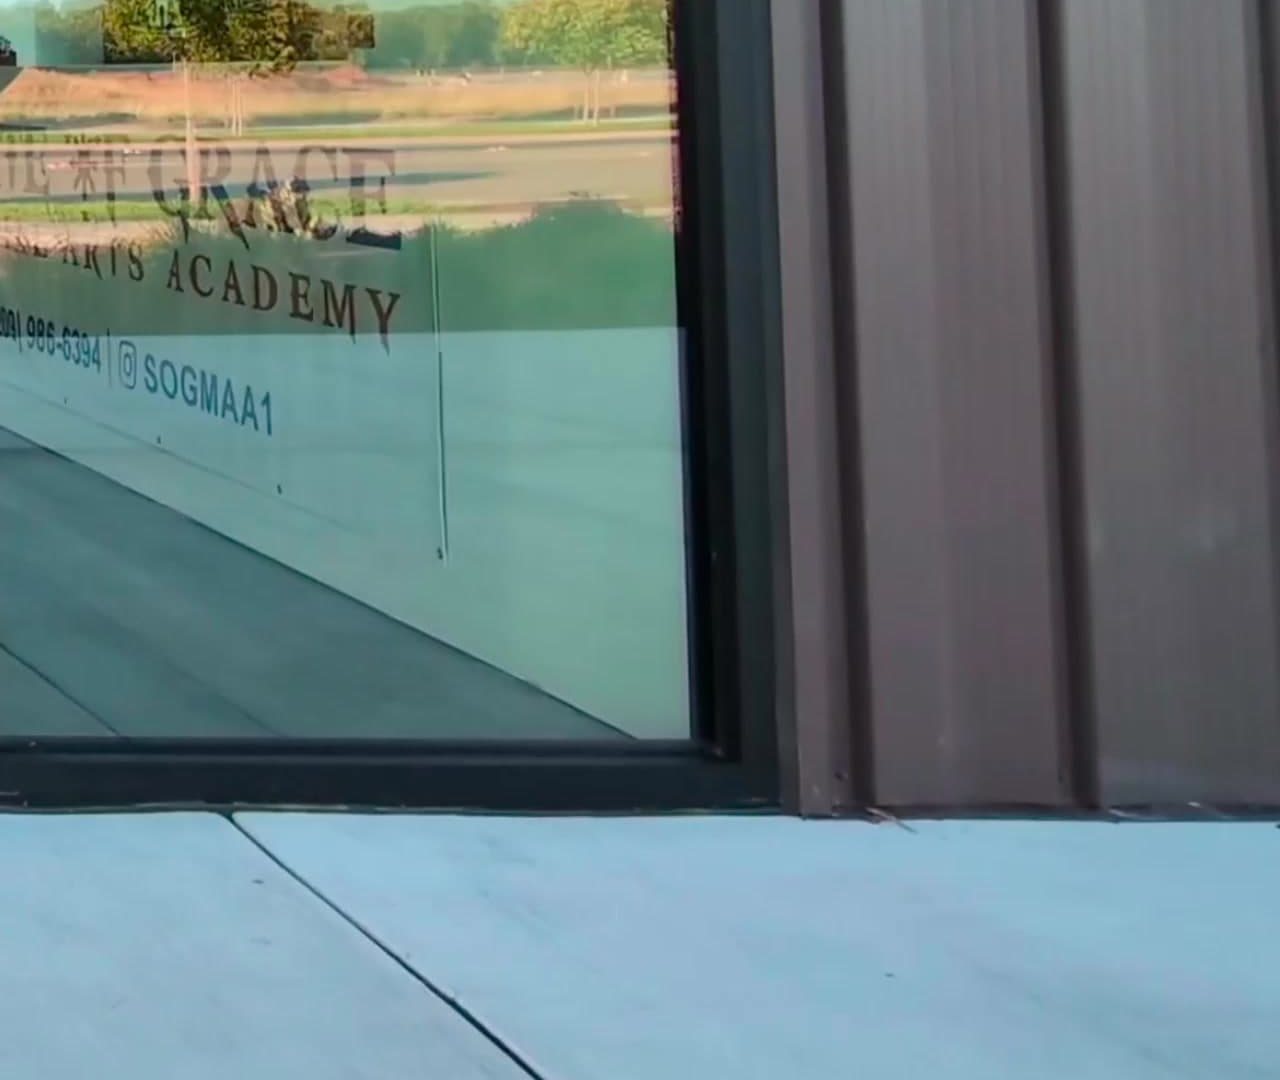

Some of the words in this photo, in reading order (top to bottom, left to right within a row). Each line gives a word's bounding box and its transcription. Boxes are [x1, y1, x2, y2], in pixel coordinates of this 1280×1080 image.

[146, 137, 402, 251] GRACE
[26, 316, 102, 373] 986-6394
[166, 249, 401, 356] ACADEMY
